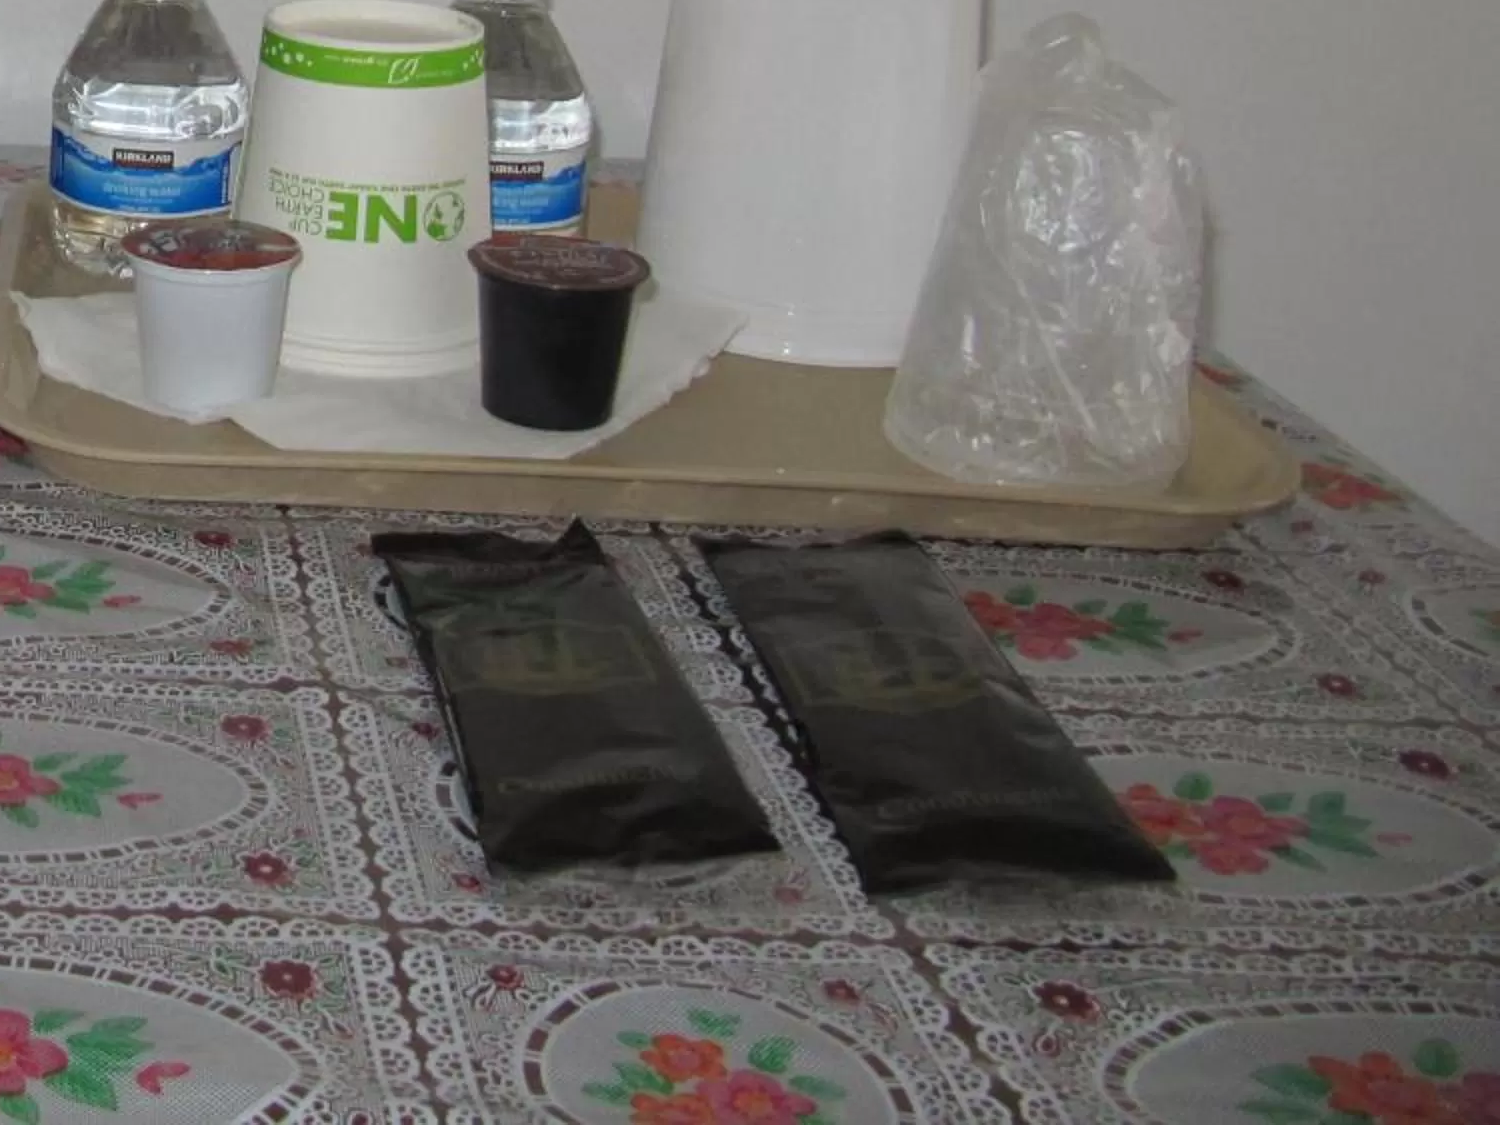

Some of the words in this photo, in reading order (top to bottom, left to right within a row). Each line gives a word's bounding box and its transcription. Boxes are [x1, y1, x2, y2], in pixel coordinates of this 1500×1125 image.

[115, 150, 173, 164] KIRKLAND
[267, 178, 325, 204] CHOICE
[275, 196, 324, 220] EARTH
[288, 218, 323, 236] CUP
